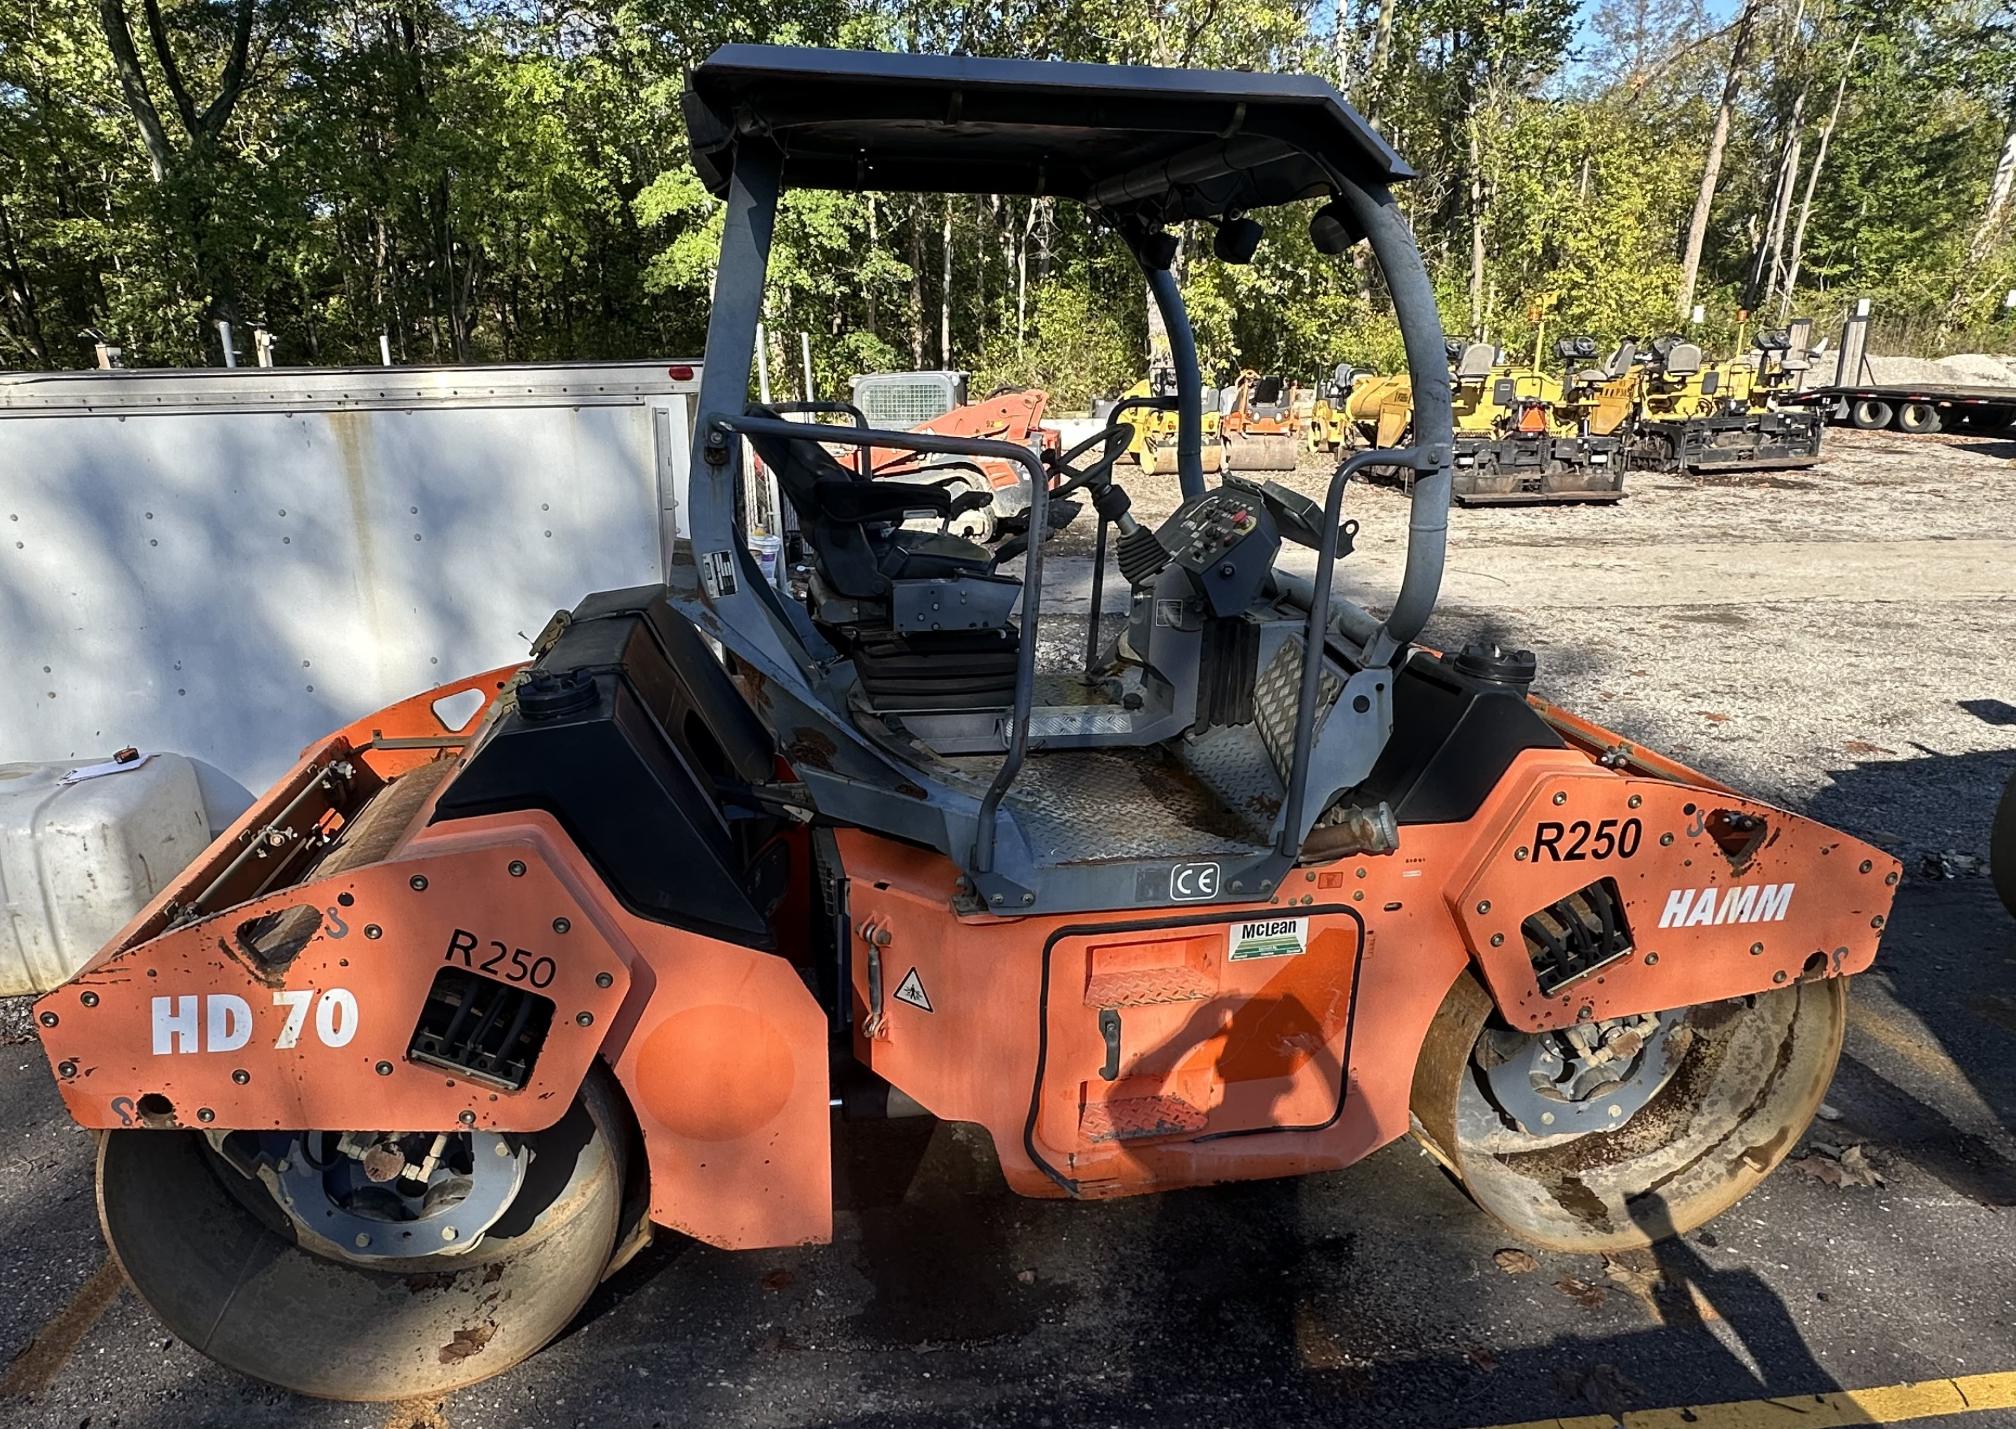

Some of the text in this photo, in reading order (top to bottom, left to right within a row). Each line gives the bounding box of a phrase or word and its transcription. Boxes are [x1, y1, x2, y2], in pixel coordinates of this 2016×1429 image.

[1531, 818, 1642, 863] R250
[1177, 868, 1214, 894] CE
[1658, 883, 1796, 929] HAMM
[1242, 920, 1297, 939] McLean
[152, 988, 359, 1056] HD 70
